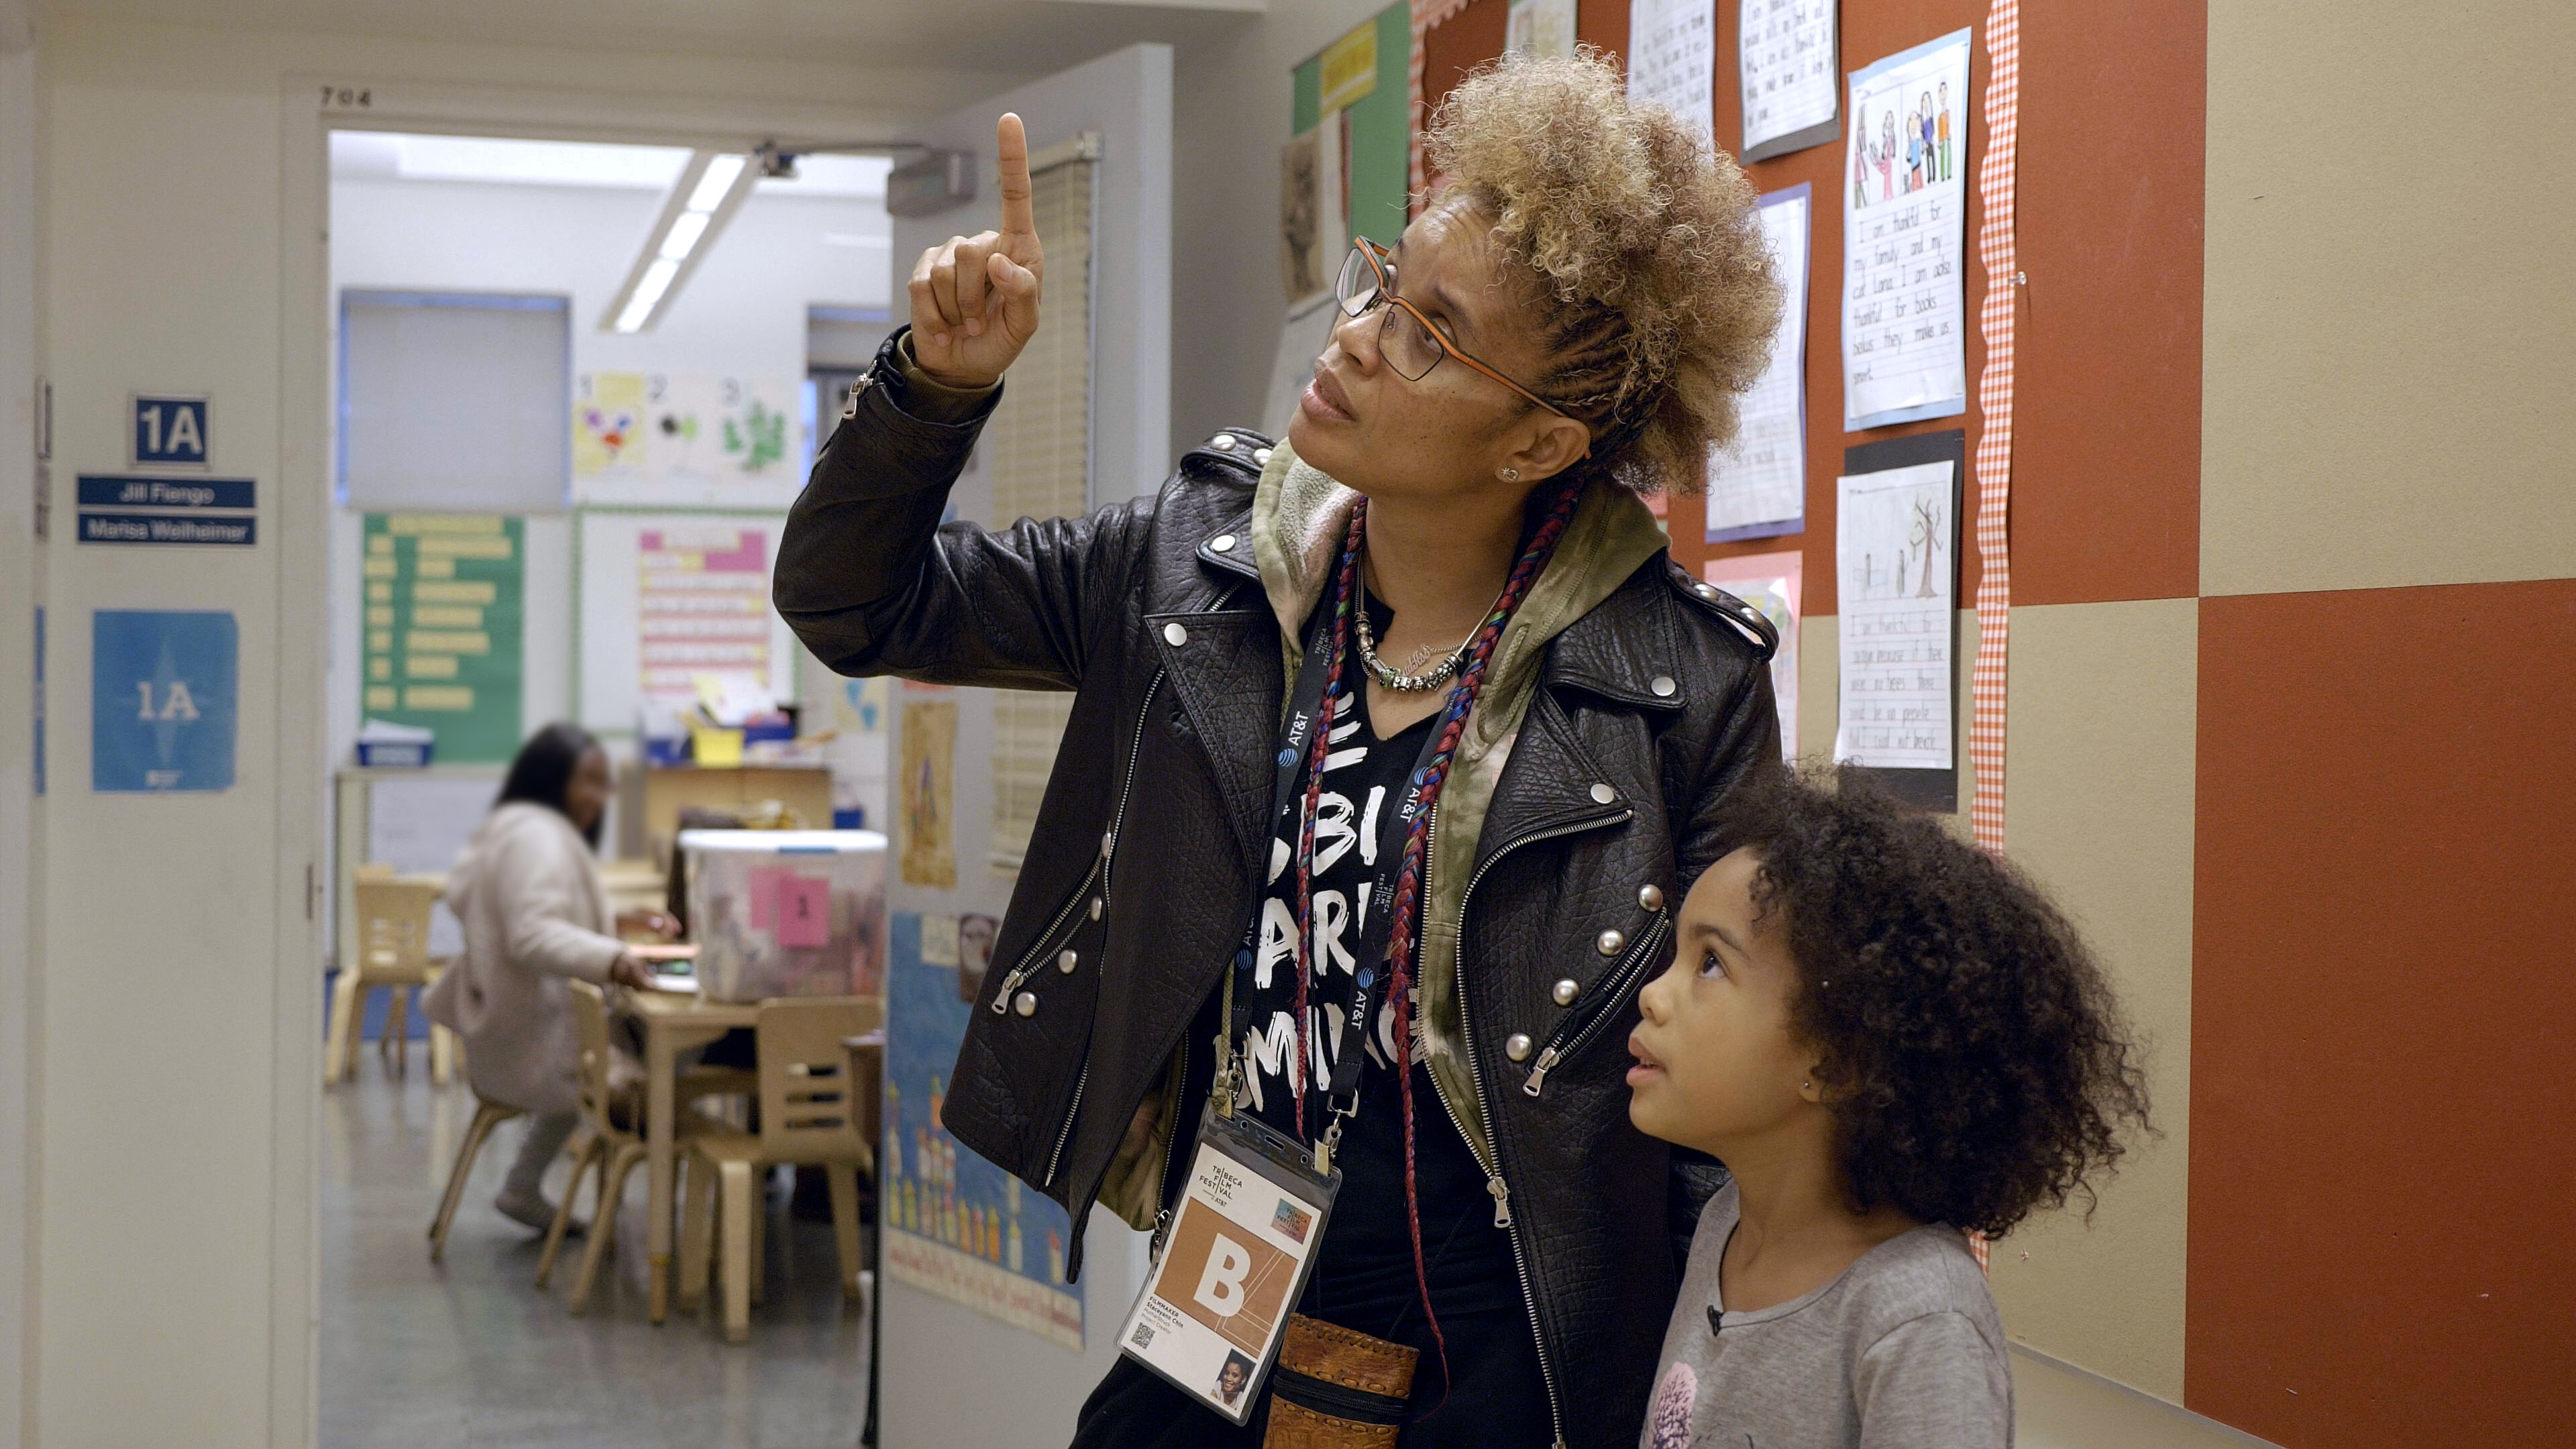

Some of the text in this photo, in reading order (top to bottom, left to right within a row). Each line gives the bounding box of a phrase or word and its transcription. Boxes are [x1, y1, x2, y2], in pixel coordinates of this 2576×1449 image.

[321, 86, 371, 107] 704
[140, 405, 203, 453] 1A
[120, 483, 147, 502] Jill
[88, 519, 148, 538] Marisa
[137, 680, 201, 721] 1A
[1288, 711, 1308, 746] AT&T
[1400, 787, 1421, 823] AT&T
[1374, 873, 1385, 906] FESTIVAL
[1383, 884, 1394, 913] TRIBECA
[1351, 991, 1366, 1030] AT&T
[1199, 1175, 1232, 1199] FESTIVAL
[1213, 1165, 1242, 1188] TRIBECA
[1214, 1175, 1232, 1189] FILM
[1215, 1197, 1227, 1208] AT&T
[1192, 1232, 1251, 1317] B
[1146, 1301, 1184, 1328] Staceyann Chin
[1150, 1296, 1179, 1317] FILMMAKER
